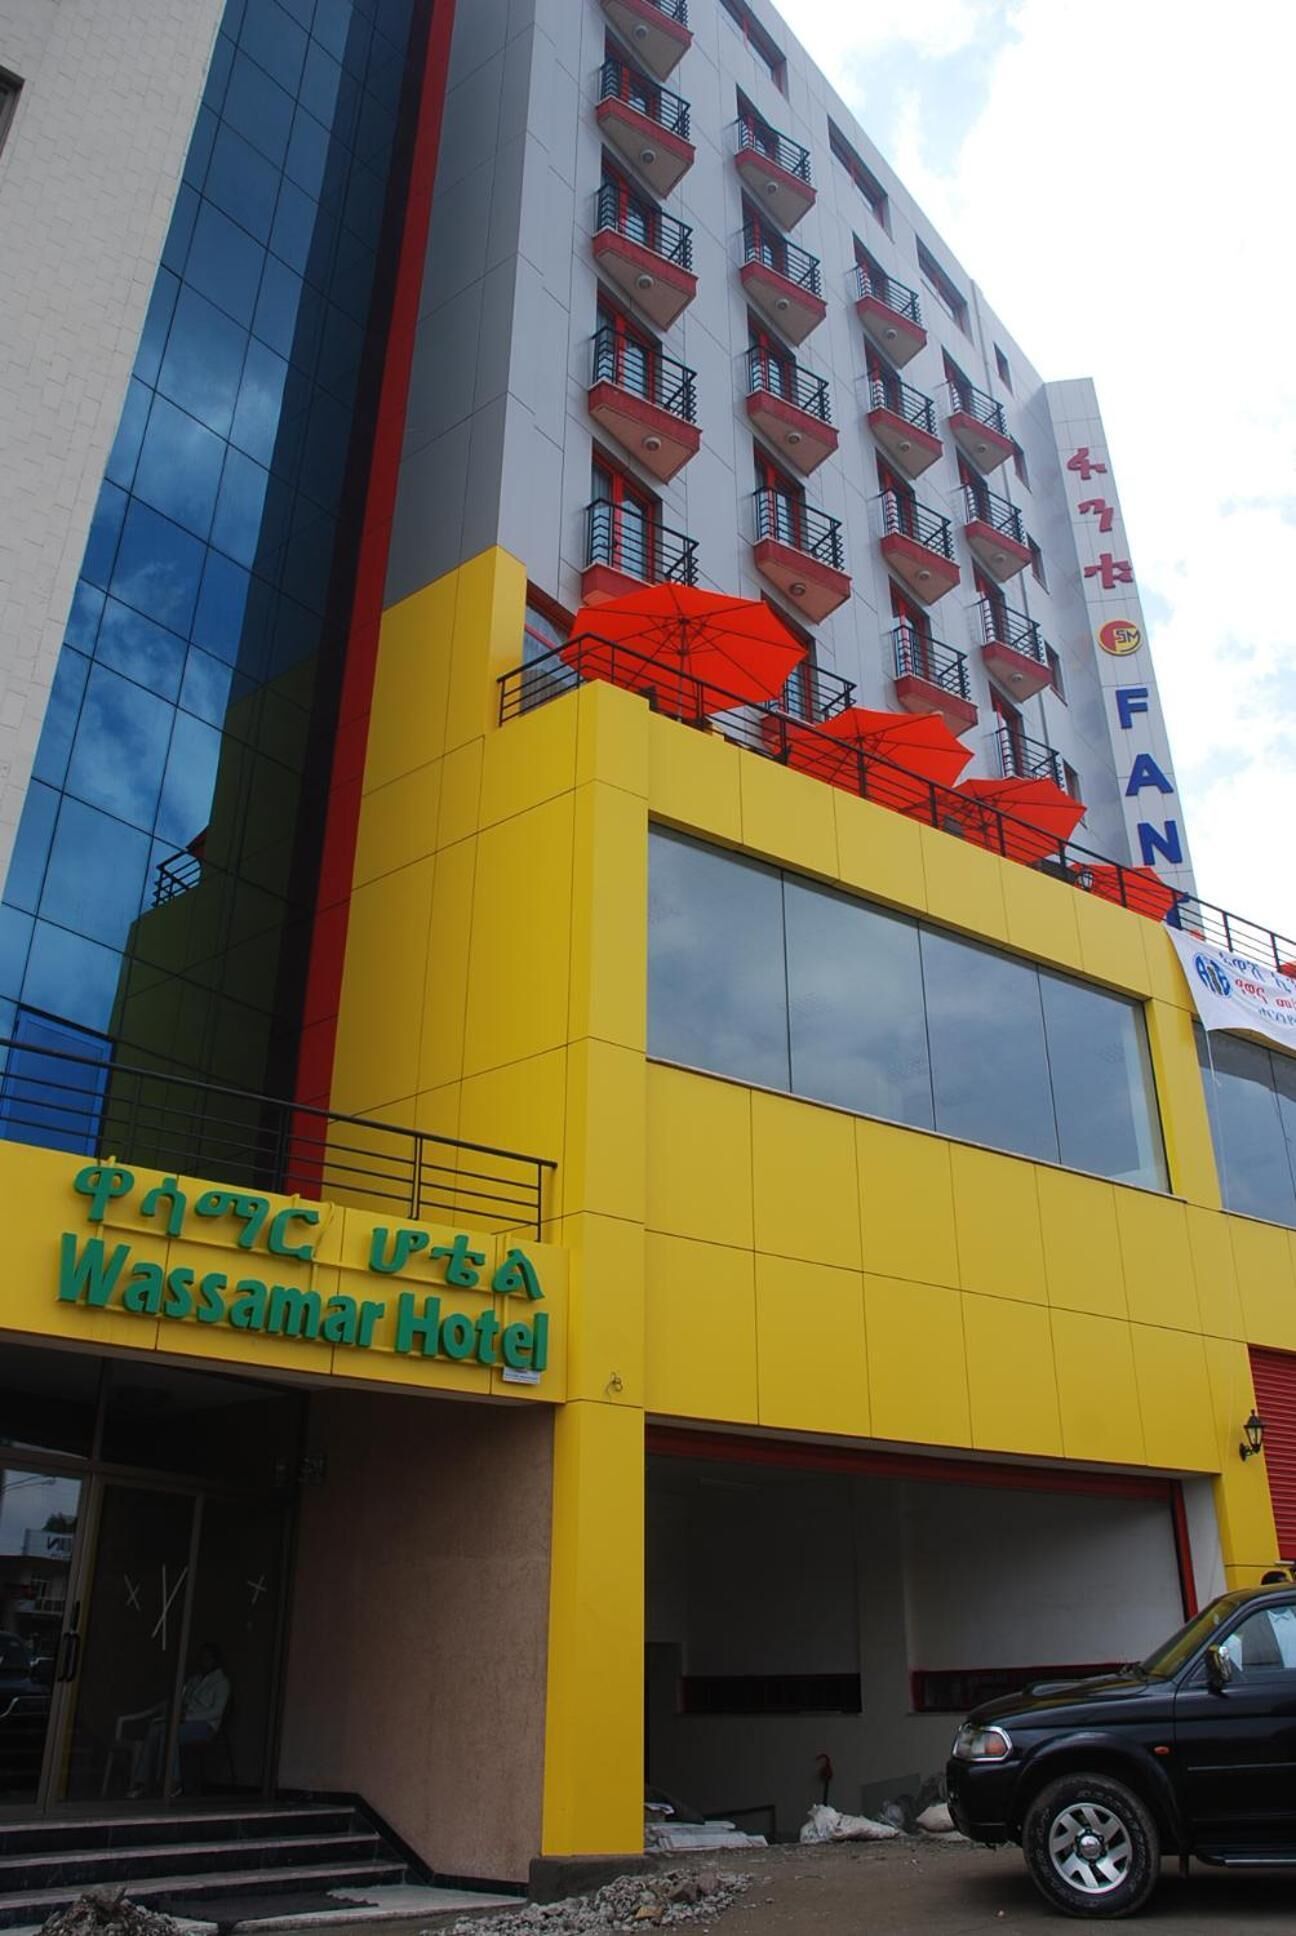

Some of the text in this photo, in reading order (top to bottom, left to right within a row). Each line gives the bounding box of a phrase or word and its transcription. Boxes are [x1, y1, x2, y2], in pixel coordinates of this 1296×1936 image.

[58, 1232, 549, 1371] Wassamar Hotel
[369, 1227, 545, 1300] ሆቴል
